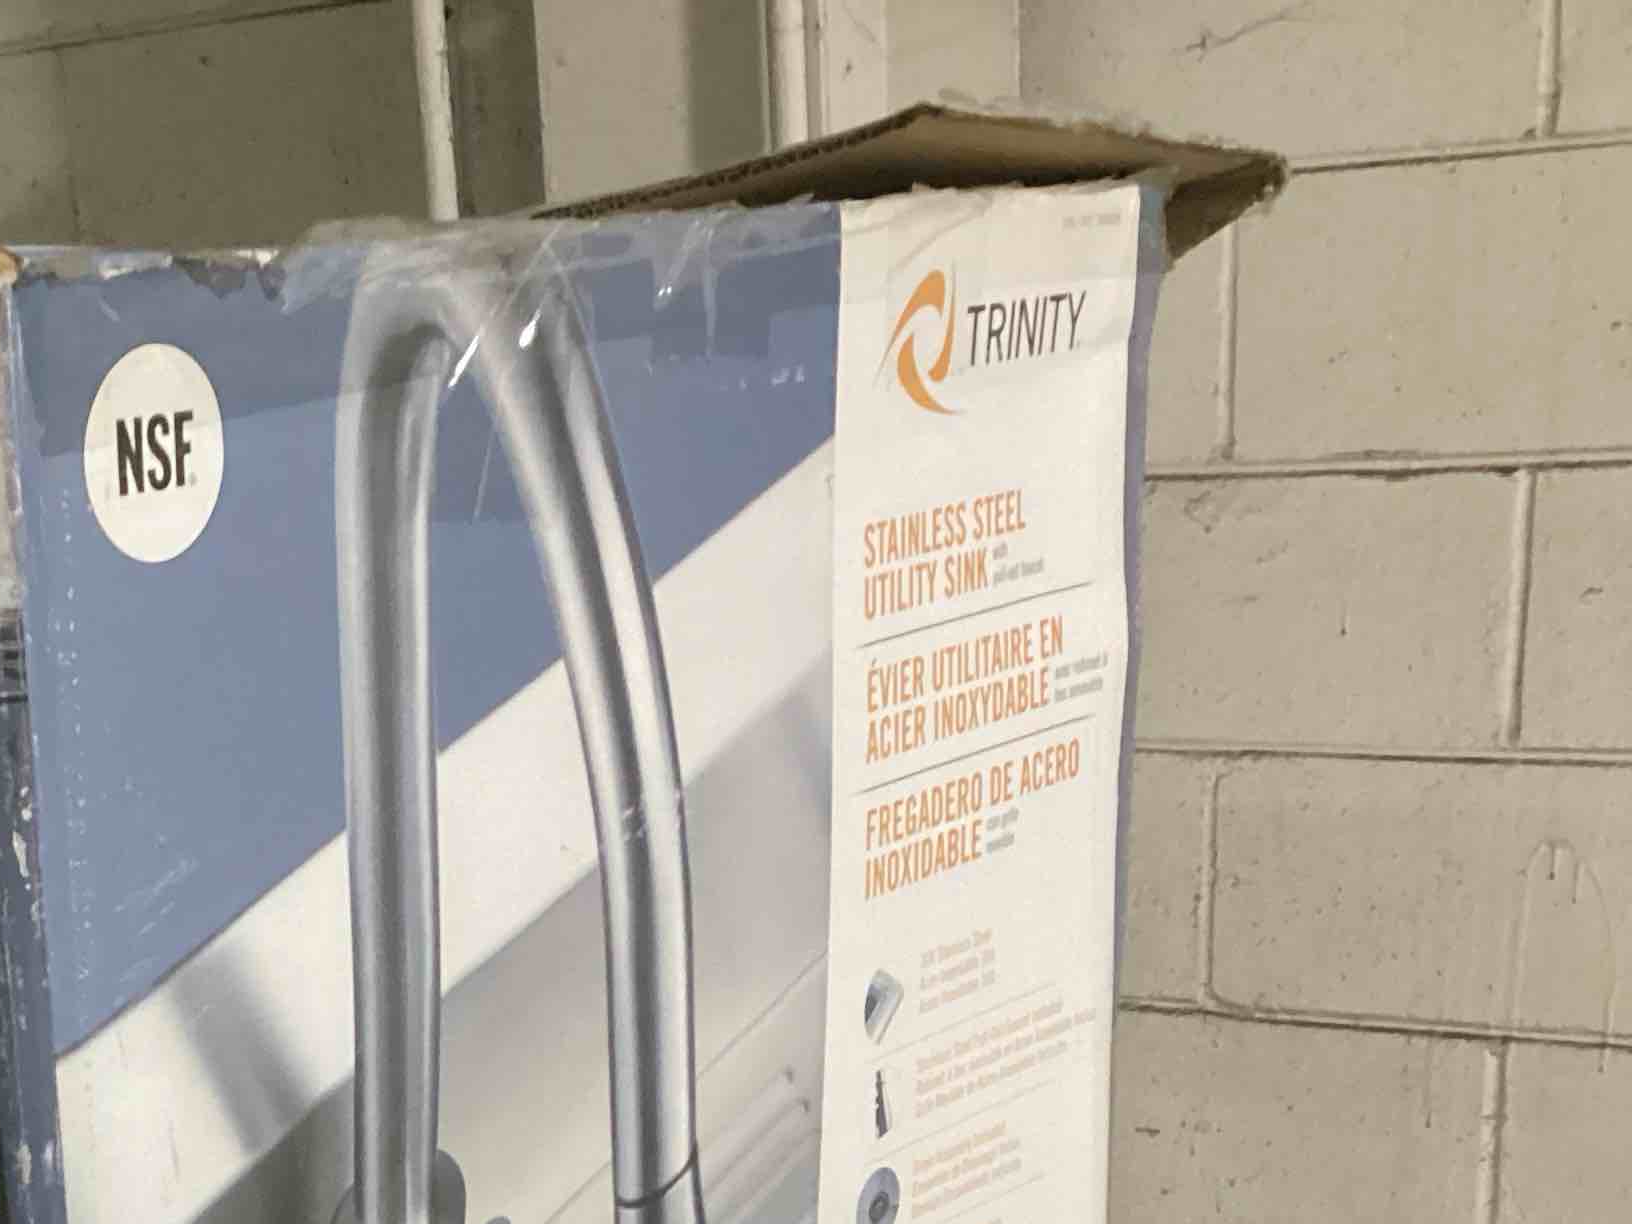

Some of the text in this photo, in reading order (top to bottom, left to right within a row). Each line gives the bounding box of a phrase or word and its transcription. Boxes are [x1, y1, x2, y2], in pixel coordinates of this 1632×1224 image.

[968, 290, 1086, 367] TRINITY
[116, 409, 193, 496] NSF
[864, 489, 1026, 568] STAINLESS STEEL
[864, 559, 937, 620] UTILITY
[944, 548, 989, 599] SINK
[867, 658, 925, 713] ÉVIER
[932, 623, 1033, 691] UTILITAIRE
[1039, 615, 1064, 659] EN
[865, 705, 926, 764] ACIER
[934, 667, 1049, 741] INOXYDABLE
[866, 771, 983, 851] FREGADERO
[989, 760, 1014, 806] DE
[1019, 737, 1080, 796] ACERO
[864, 818, 983, 902] INOXIDABLE
